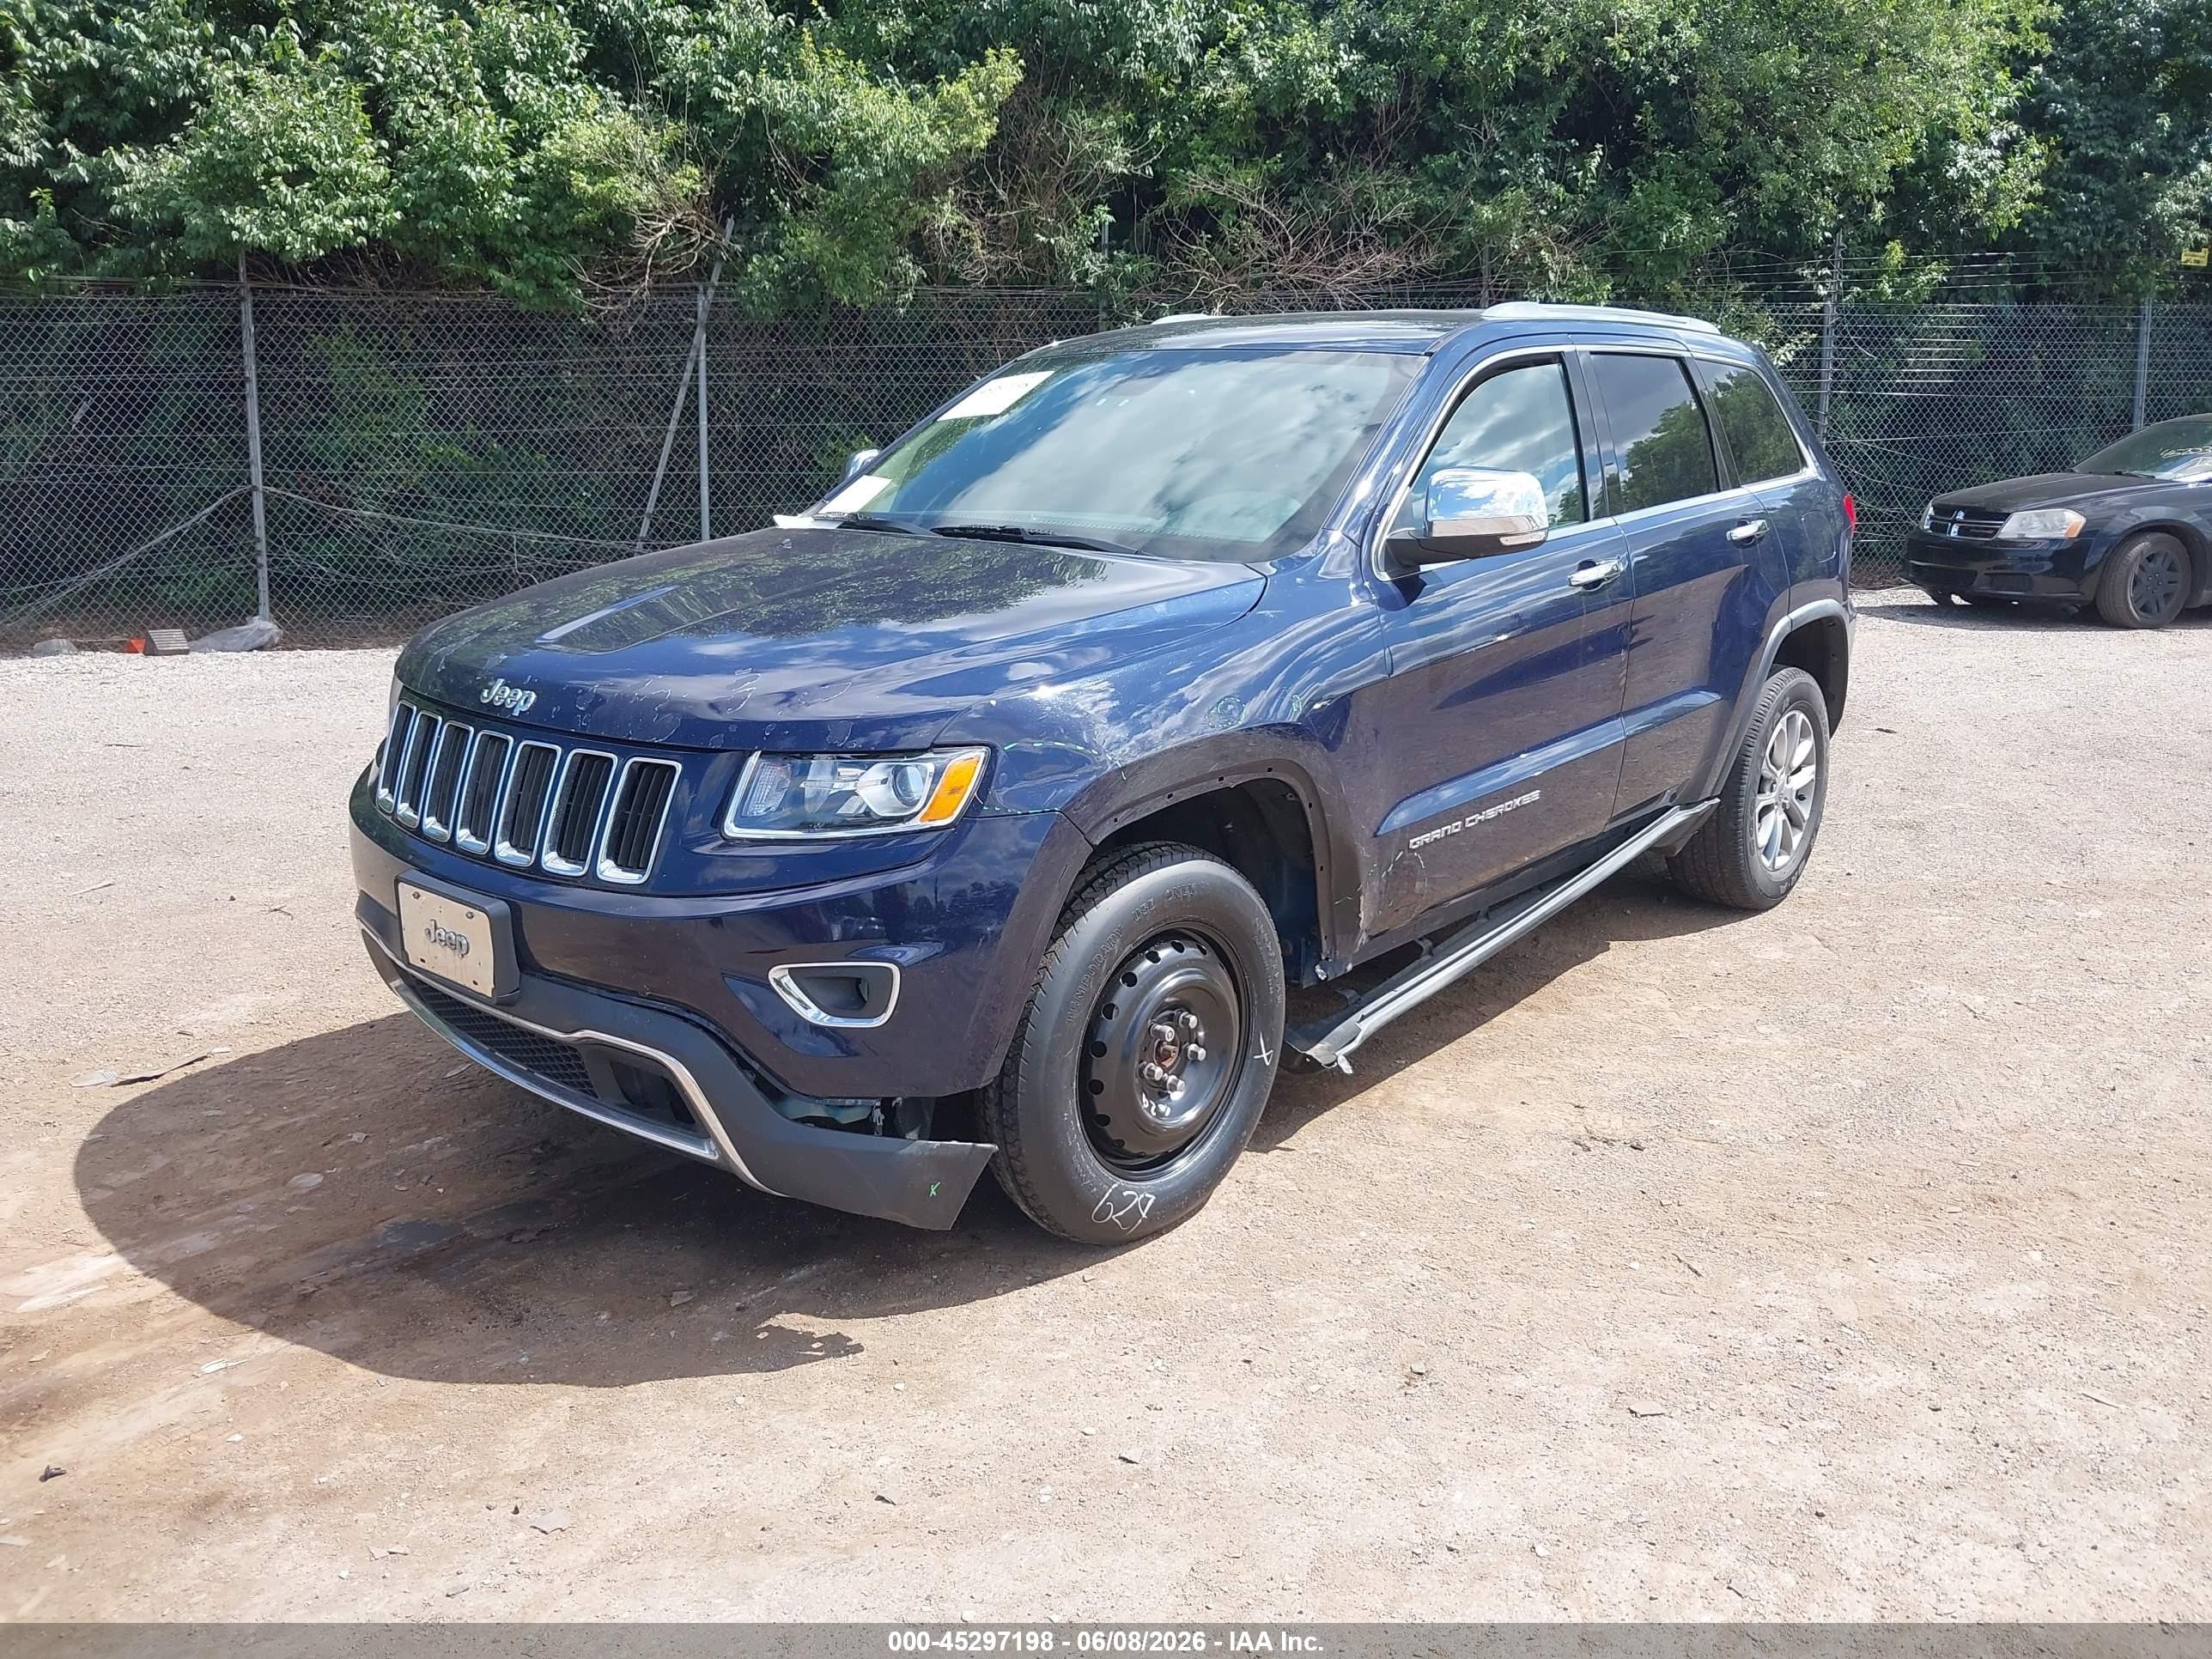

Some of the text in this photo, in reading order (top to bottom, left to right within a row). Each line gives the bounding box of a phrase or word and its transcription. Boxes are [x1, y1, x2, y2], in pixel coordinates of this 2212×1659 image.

[480, 678, 538, 717] Jeep
[1408, 789, 1541, 849] GRAND CHEROKEE
[424, 919, 470, 959] Jeep
[1064, 882, 1196, 1024] TEMPORARY USE ONLY
